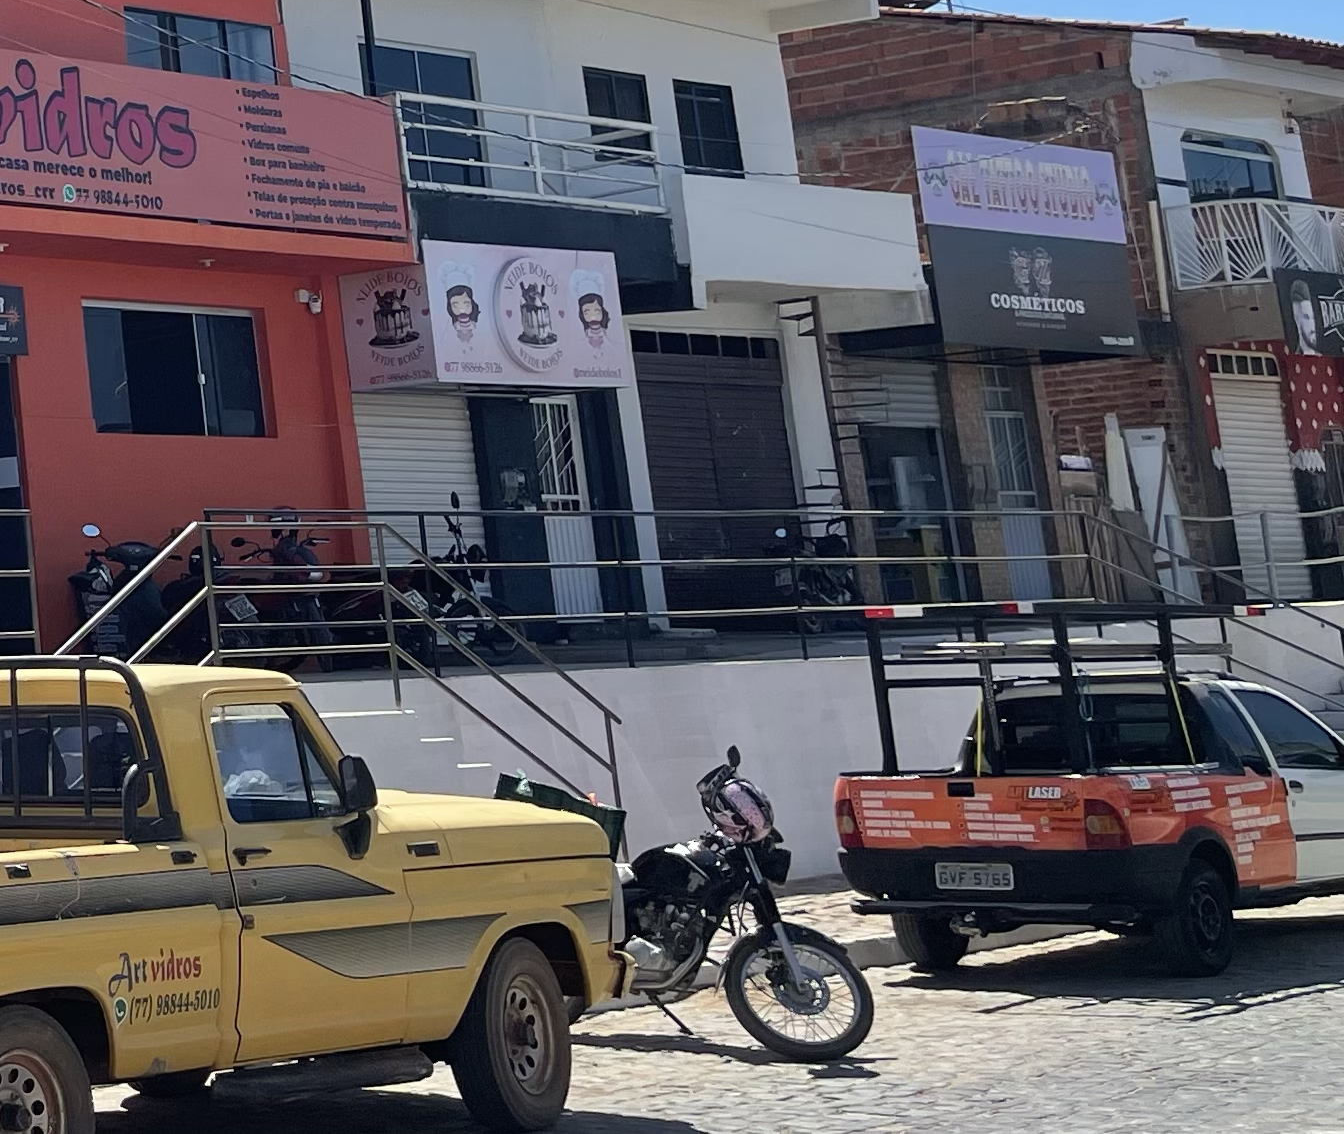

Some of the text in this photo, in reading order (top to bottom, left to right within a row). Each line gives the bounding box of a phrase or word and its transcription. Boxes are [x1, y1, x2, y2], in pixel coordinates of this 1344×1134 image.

[242, 88, 279, 101] Espelhos
[244, 105, 282, 117] Molduras
[246, 122, 286, 135] Persianas
[247, 138, 310, 154] Vidros comuns
[33, 159, 84, 178] merece
[89, 167, 97, 178] o
[101, 167, 152, 185] melhor!
[249, 156, 325, 172] Box para banheiro
[251, 173, 304, 188] Fechamento
[306, 178, 315, 189] de
[318, 179, 330, 191] pia
[339, 181, 365, 193] balcão
[76, 188, 90, 203] 77
[94, 189, 163, 210] 98844-5010
[253, 191, 398, 213] Telas de proteção contra mosquitos
[255, 208, 283, 220] Portas
[292, 210, 321, 224] janelas
[323, 212, 333, 224] de
[335, 215, 357, 226] vidro
[358, 216, 402, 230] temperado
[504, 262, 528, 294] NEIDE
[991, 292, 1085, 314] COSMÉTICOS
[1320, 300, 1344, 328] BAR
[108, 947, 201, 998] Art vidros
[129, 988, 220, 1025] (77) 98844-5010
